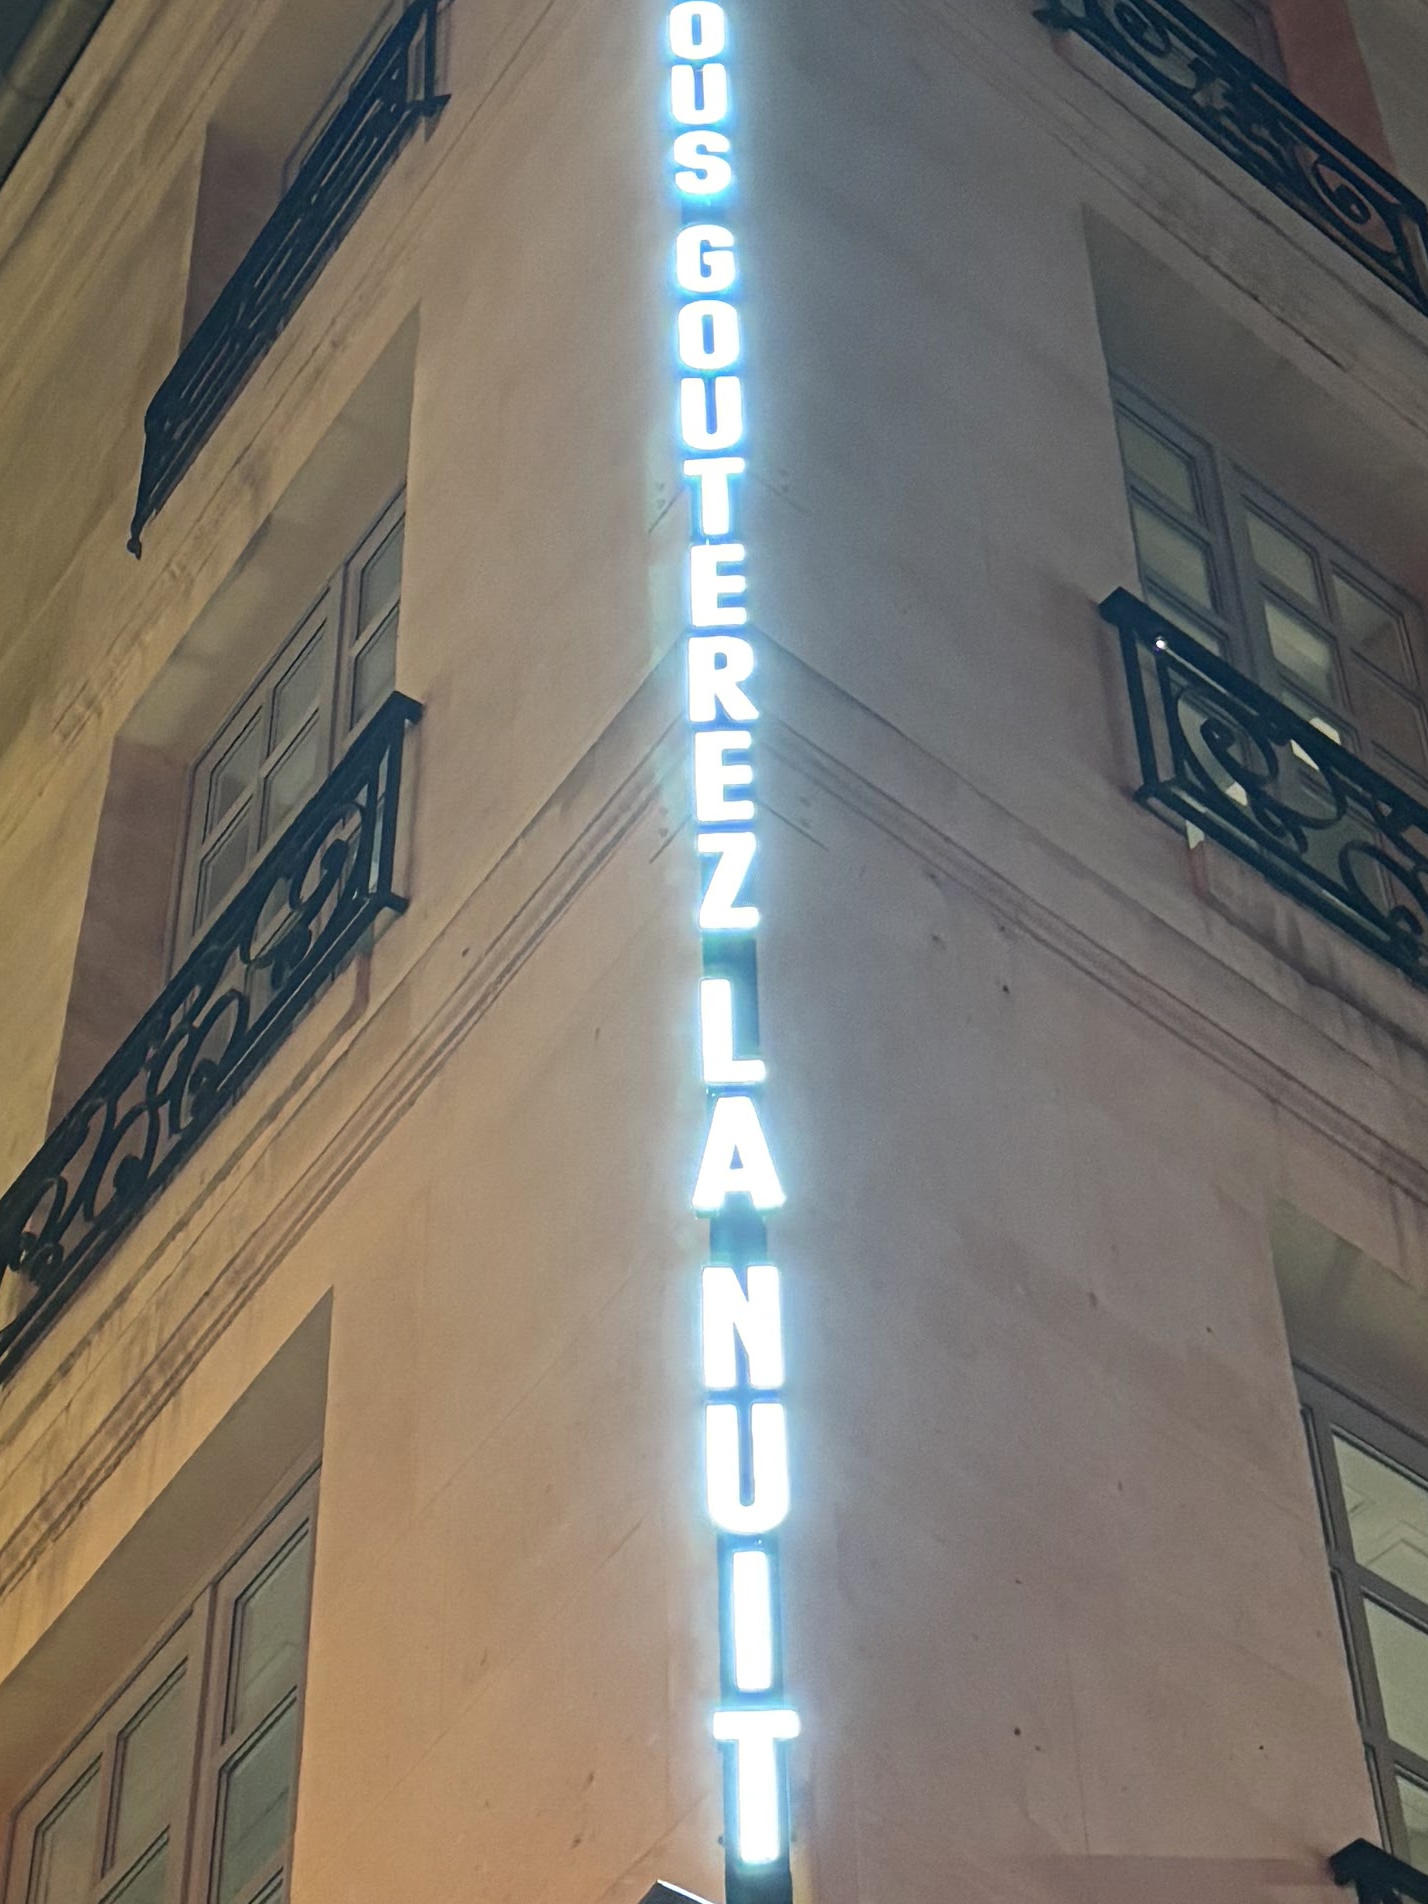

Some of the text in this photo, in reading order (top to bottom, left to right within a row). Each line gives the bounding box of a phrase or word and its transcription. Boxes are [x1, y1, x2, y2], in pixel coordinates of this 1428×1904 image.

[675, 224, 760, 930] GOUTEREZ
[691, 978, 786, 1209] LA
[701, 1265, 801, 1862] NUIT
